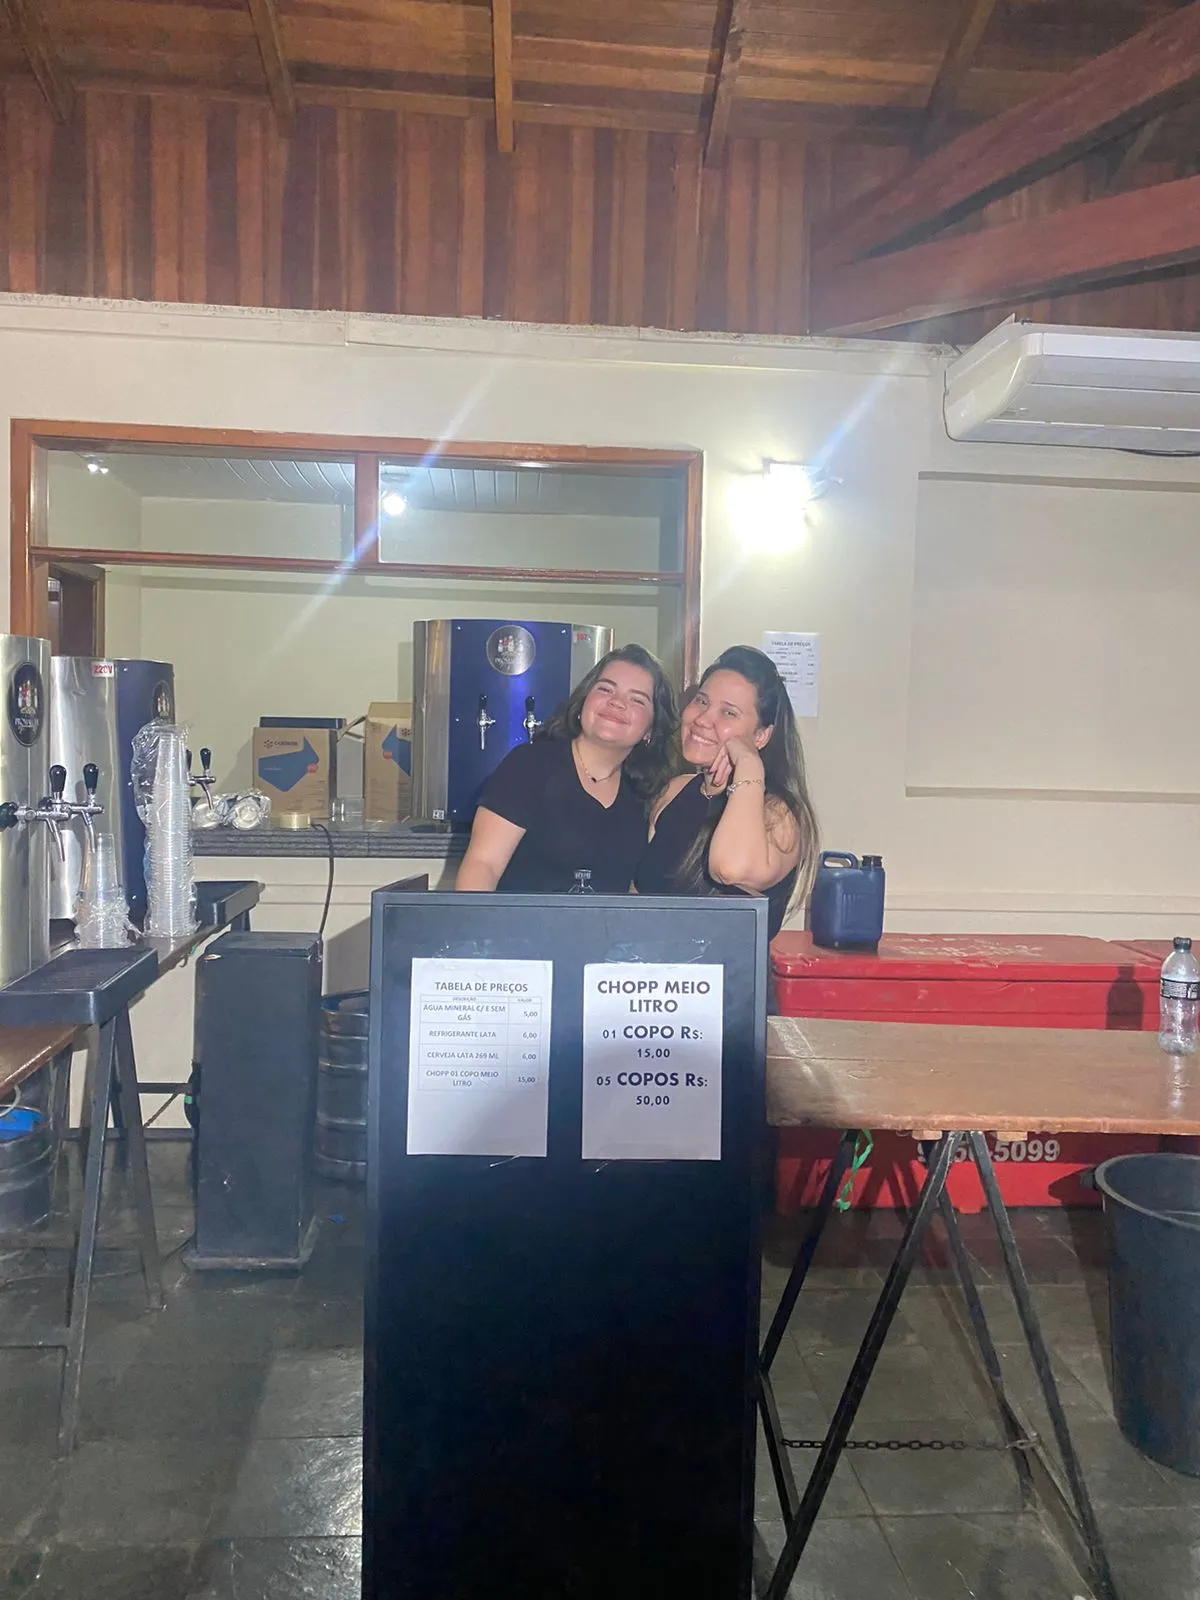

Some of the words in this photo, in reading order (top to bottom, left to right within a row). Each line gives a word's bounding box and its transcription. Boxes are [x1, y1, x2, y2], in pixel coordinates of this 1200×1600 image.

[435, 982, 472, 991] TABELA
[475, 983, 487, 991] DE
[490, 983, 528, 994] PREÇOS
[597, 980, 659, 994] CHOPP
[664, 981, 711, 994] MEIO
[629, 999, 679, 1013] LITRO
[457, 1013, 472, 1021] GÁS
[429, 1030, 478, 1038] REFRIGERANTE
[522, 1032, 537, 1040] 6,00
[602, 1029, 617, 1039] 01
[623, 1025, 675, 1039] COPO
[427, 1051, 456, 1059] CERVEJA
[457, 1051, 474, 1059] LATA
[488, 1052, 499, 1060] ML
[522, 1053, 536, 1061] 6,00
[637, 1048, 671, 1059] 15,00
[450, 1070, 458, 1078] 01
[459, 1070, 479, 1078] COPO
[452, 1079, 472, 1087] LITRO
[518, 1076, 536, 1084] 15,00
[596, 1076, 612, 1086] 05
[617, 1072, 680, 1086] COPOS
[636, 1095, 670, 1107] 50,00
